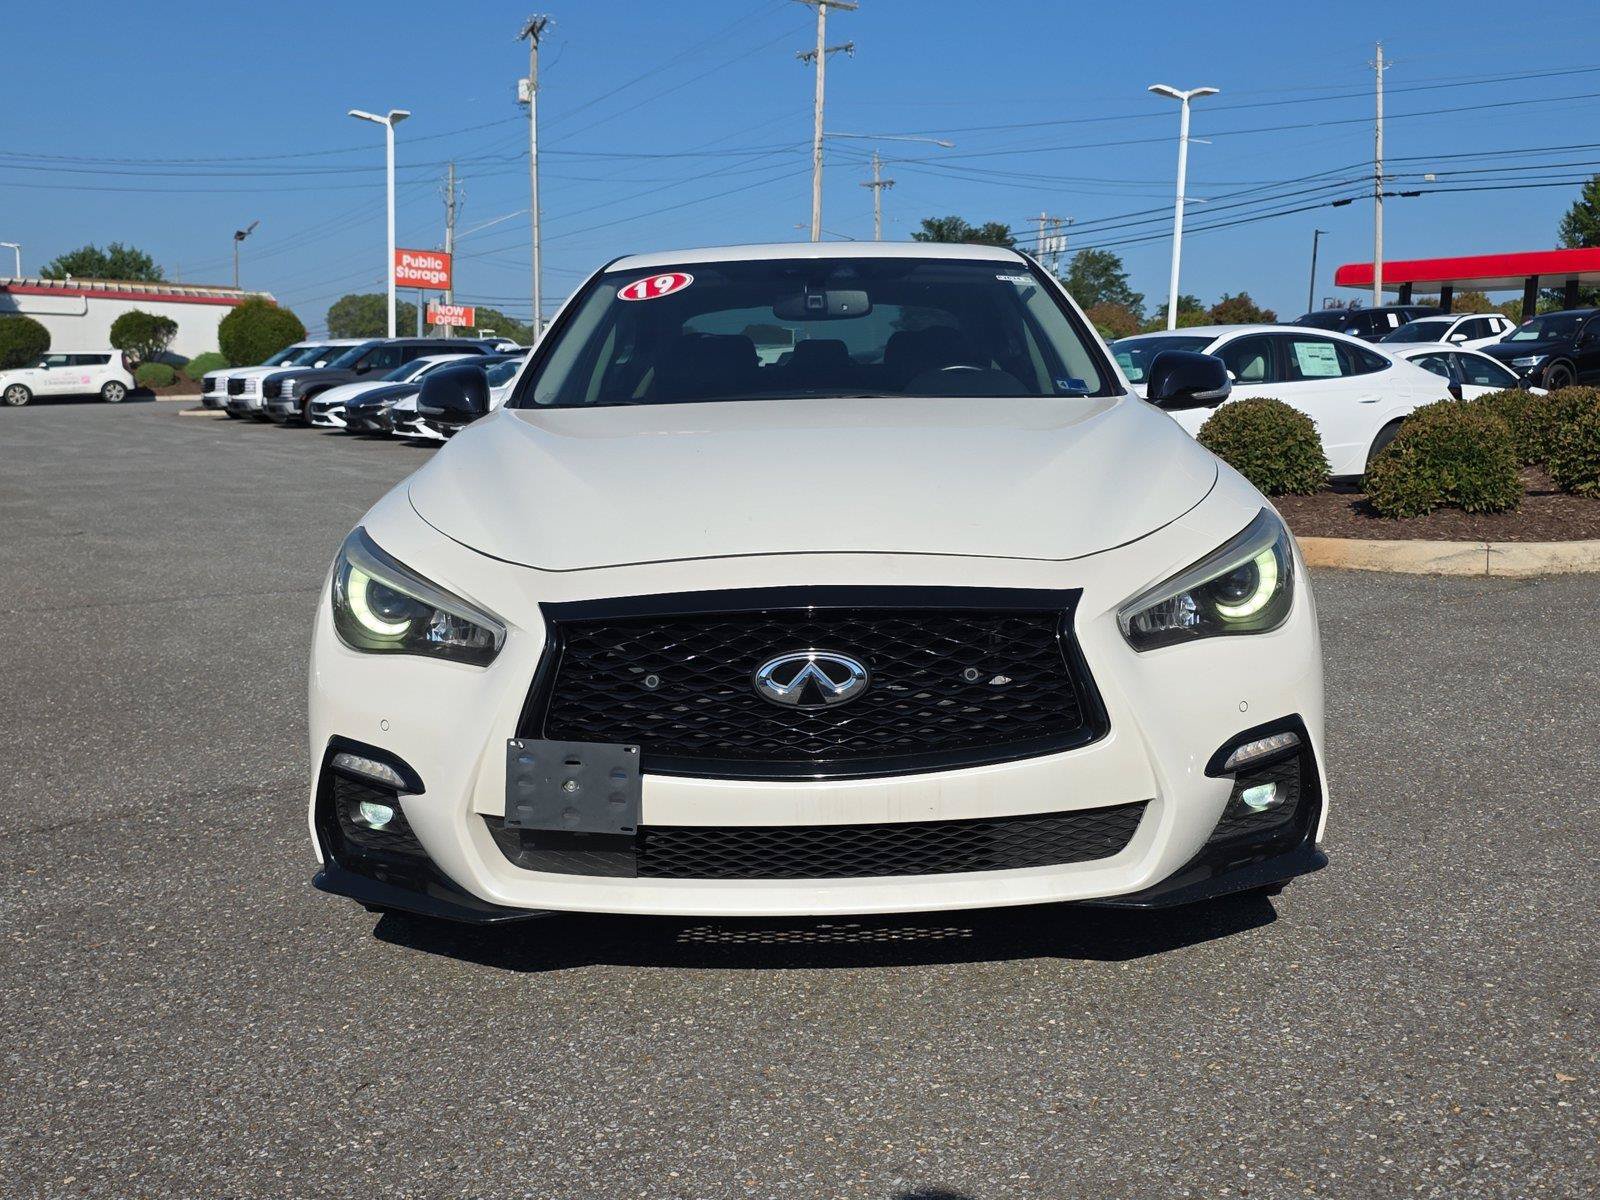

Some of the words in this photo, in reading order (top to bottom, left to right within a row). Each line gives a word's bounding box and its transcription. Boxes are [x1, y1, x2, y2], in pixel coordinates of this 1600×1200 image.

[402, 255, 443, 269] Public
[396, 265, 447, 284] Storage
[633, 275, 675, 298] 19
[437, 305, 464, 316] NOW
[435, 316, 466, 326] OPEN
